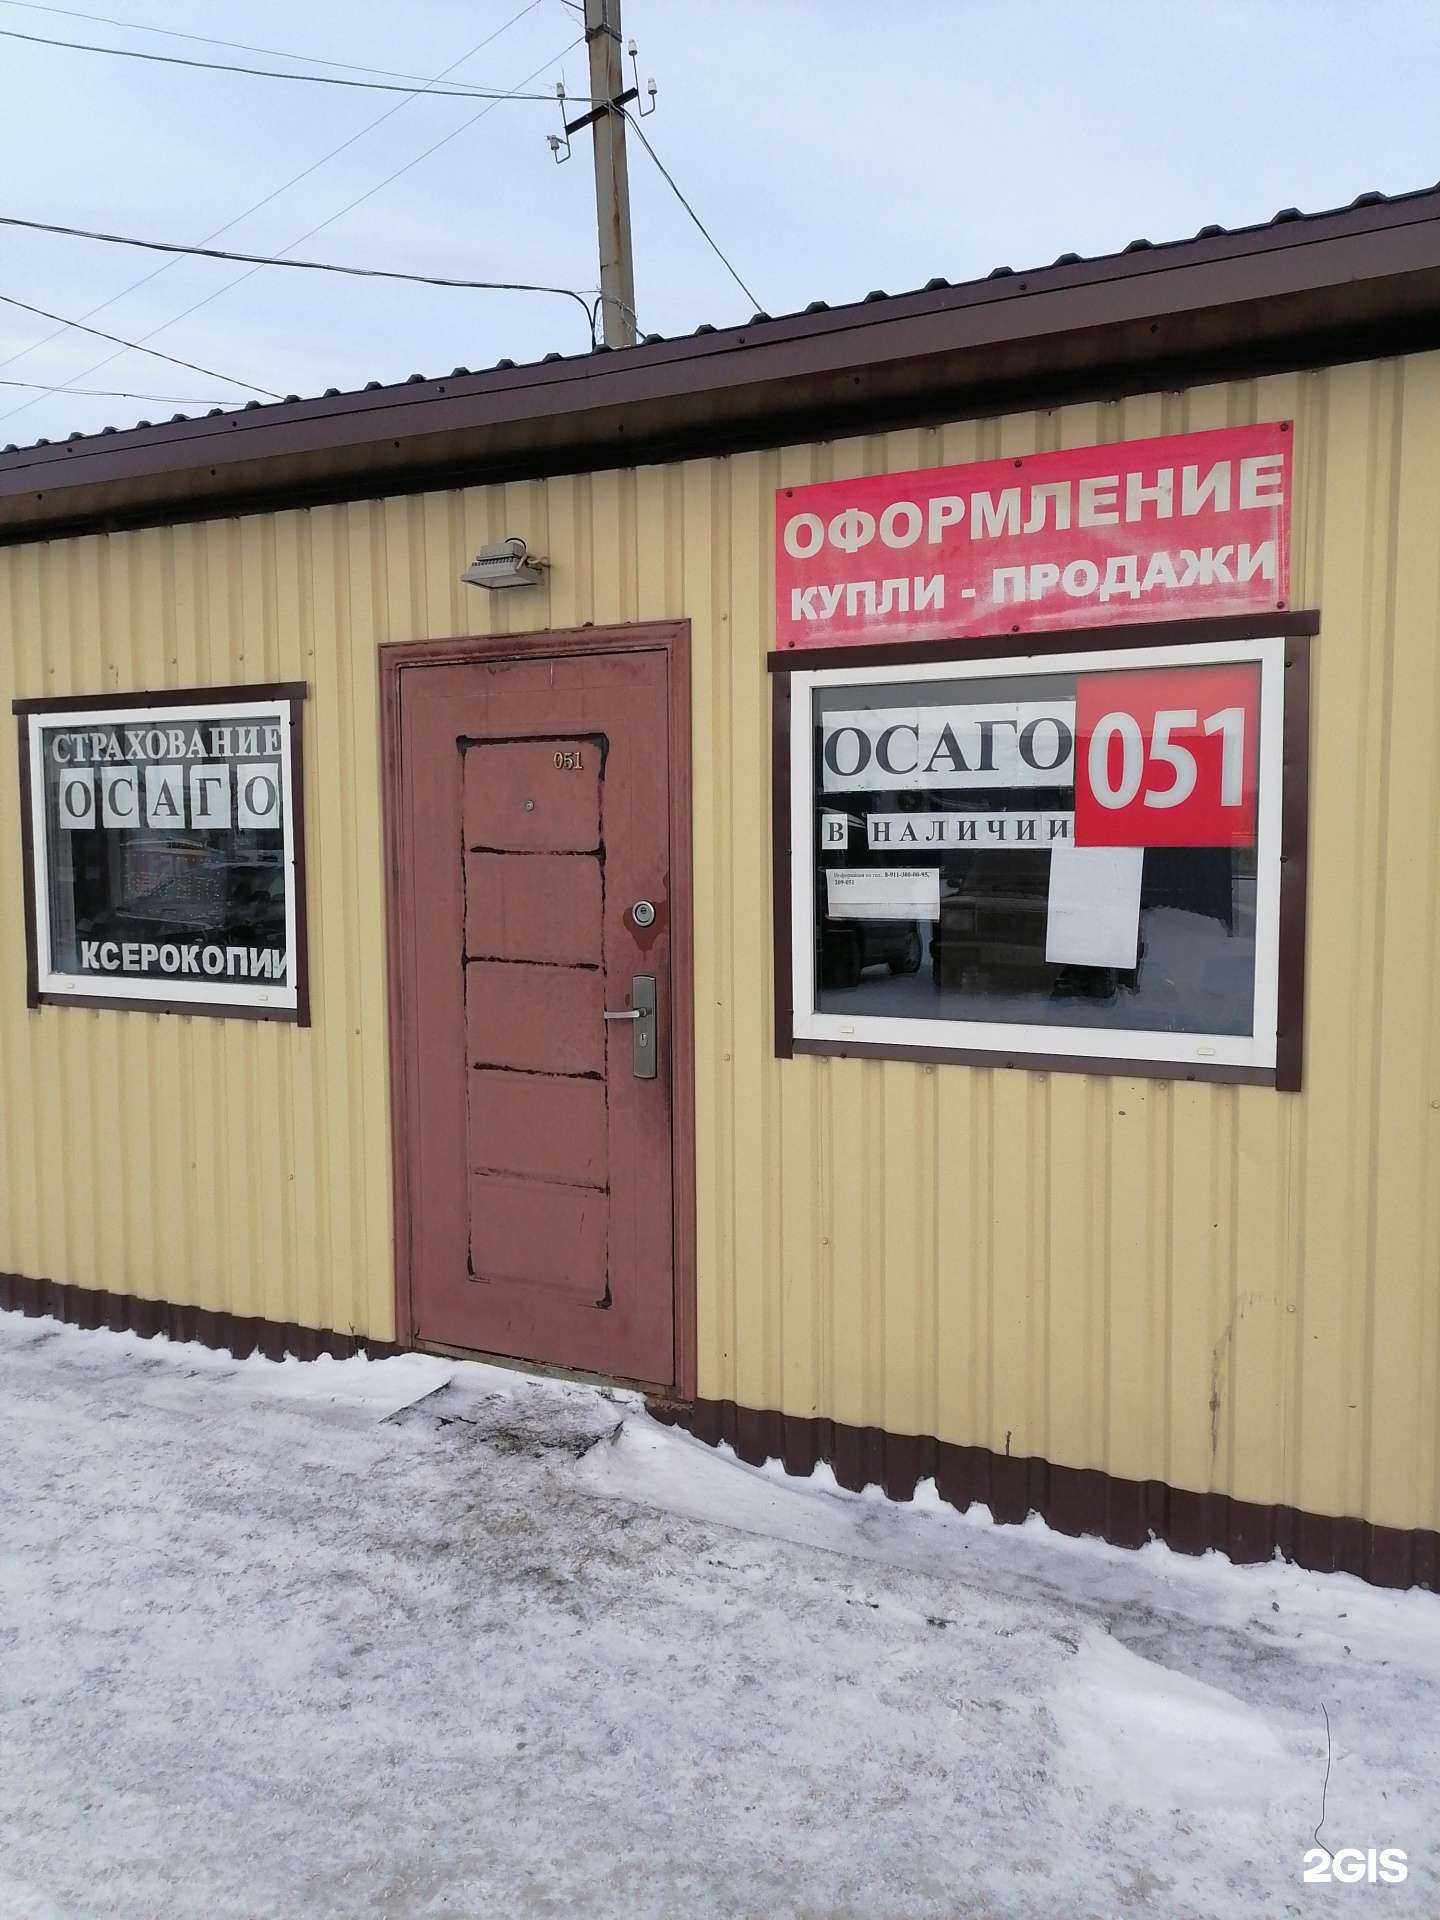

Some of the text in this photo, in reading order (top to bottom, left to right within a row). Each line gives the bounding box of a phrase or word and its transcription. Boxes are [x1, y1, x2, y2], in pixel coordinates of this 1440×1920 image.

[783, 453, 1284, 559] ОФОРМЛЕНИЕ
[791, 574, 945, 621] КУПЛИ
[992, 539, 1275, 604] ПРОДАЖИ
[52, 726, 282, 762] СТРАХОВАНИЕ
[553, 752, 584, 770] 051
[824, 717, 1073, 777] ОСАГО
[1087, 706, 1246, 811] 051
[64, 775, 277, 818] ОСАГО
[828, 820, 1070, 842] В НАЛИЧИИ
[81, 941, 288, 979] КСЕРОКОПИИ
